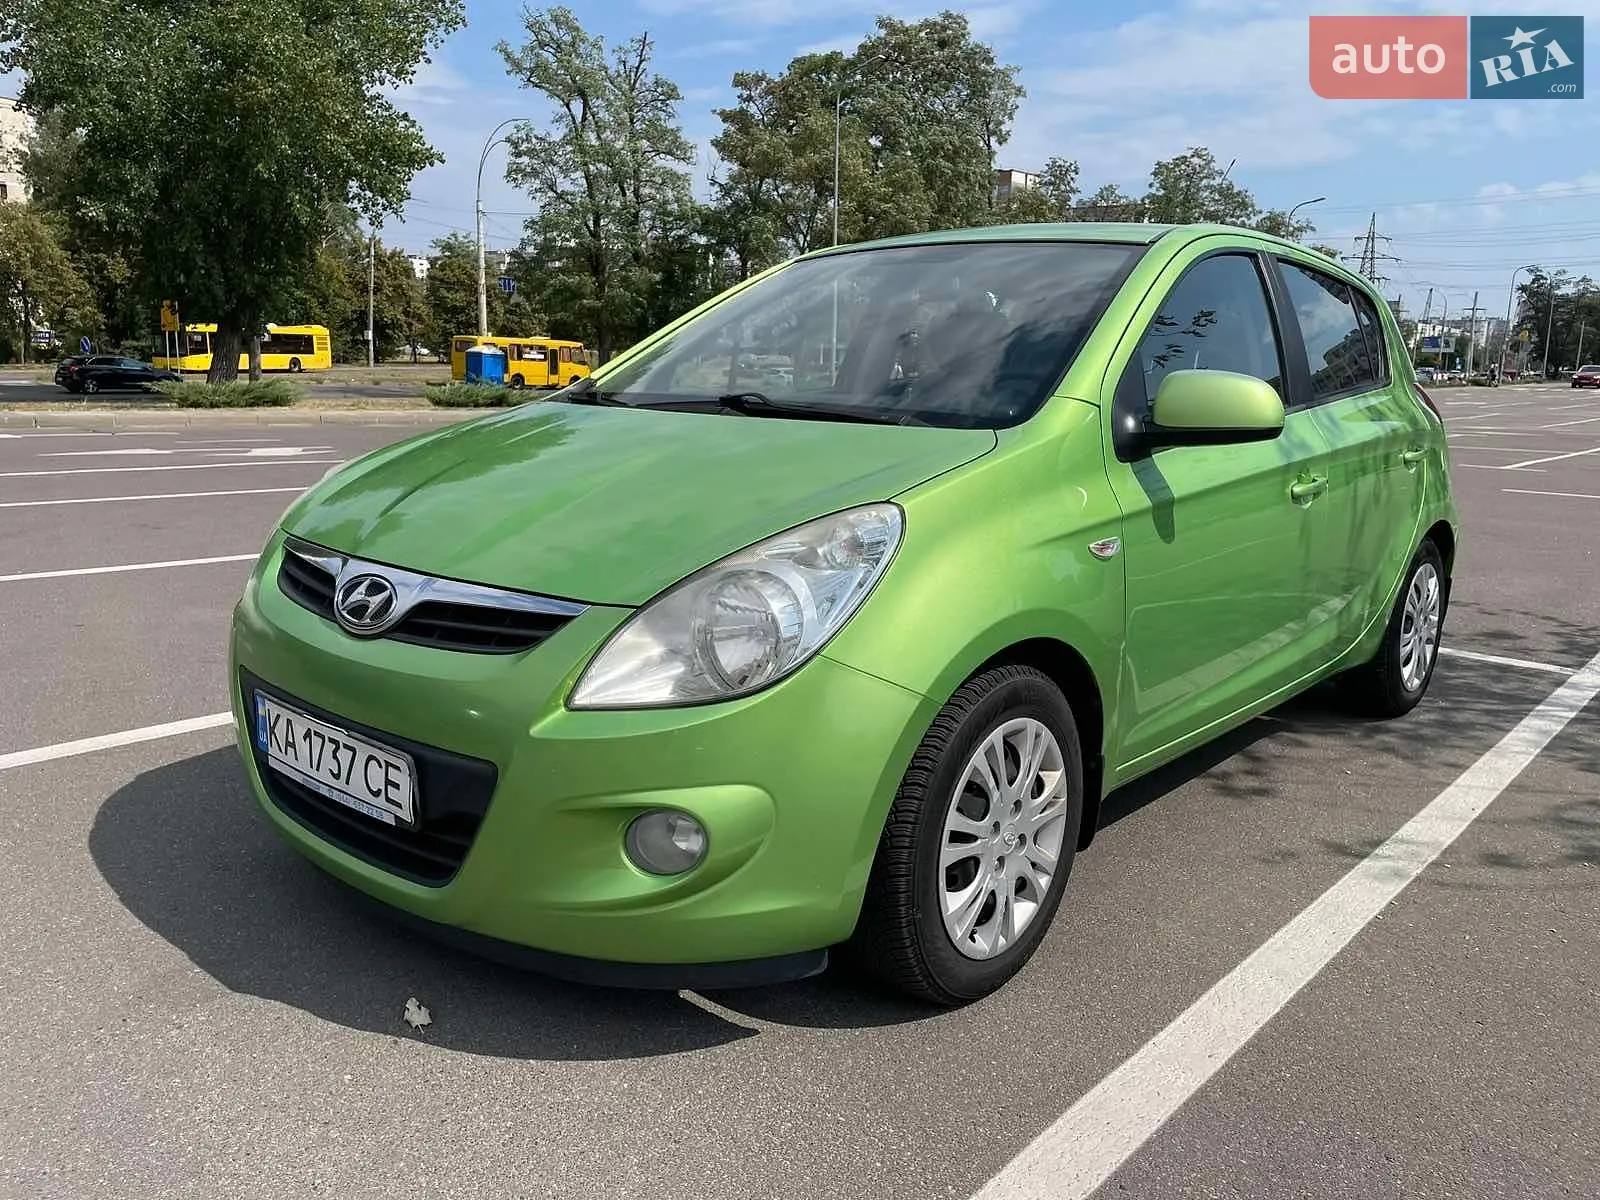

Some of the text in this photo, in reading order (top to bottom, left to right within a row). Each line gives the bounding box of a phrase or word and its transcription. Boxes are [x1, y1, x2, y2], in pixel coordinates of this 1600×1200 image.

[267, 708, 298, 761] KA
[302, 727, 357, 786] 1737
[364, 753, 403, 810] CE
